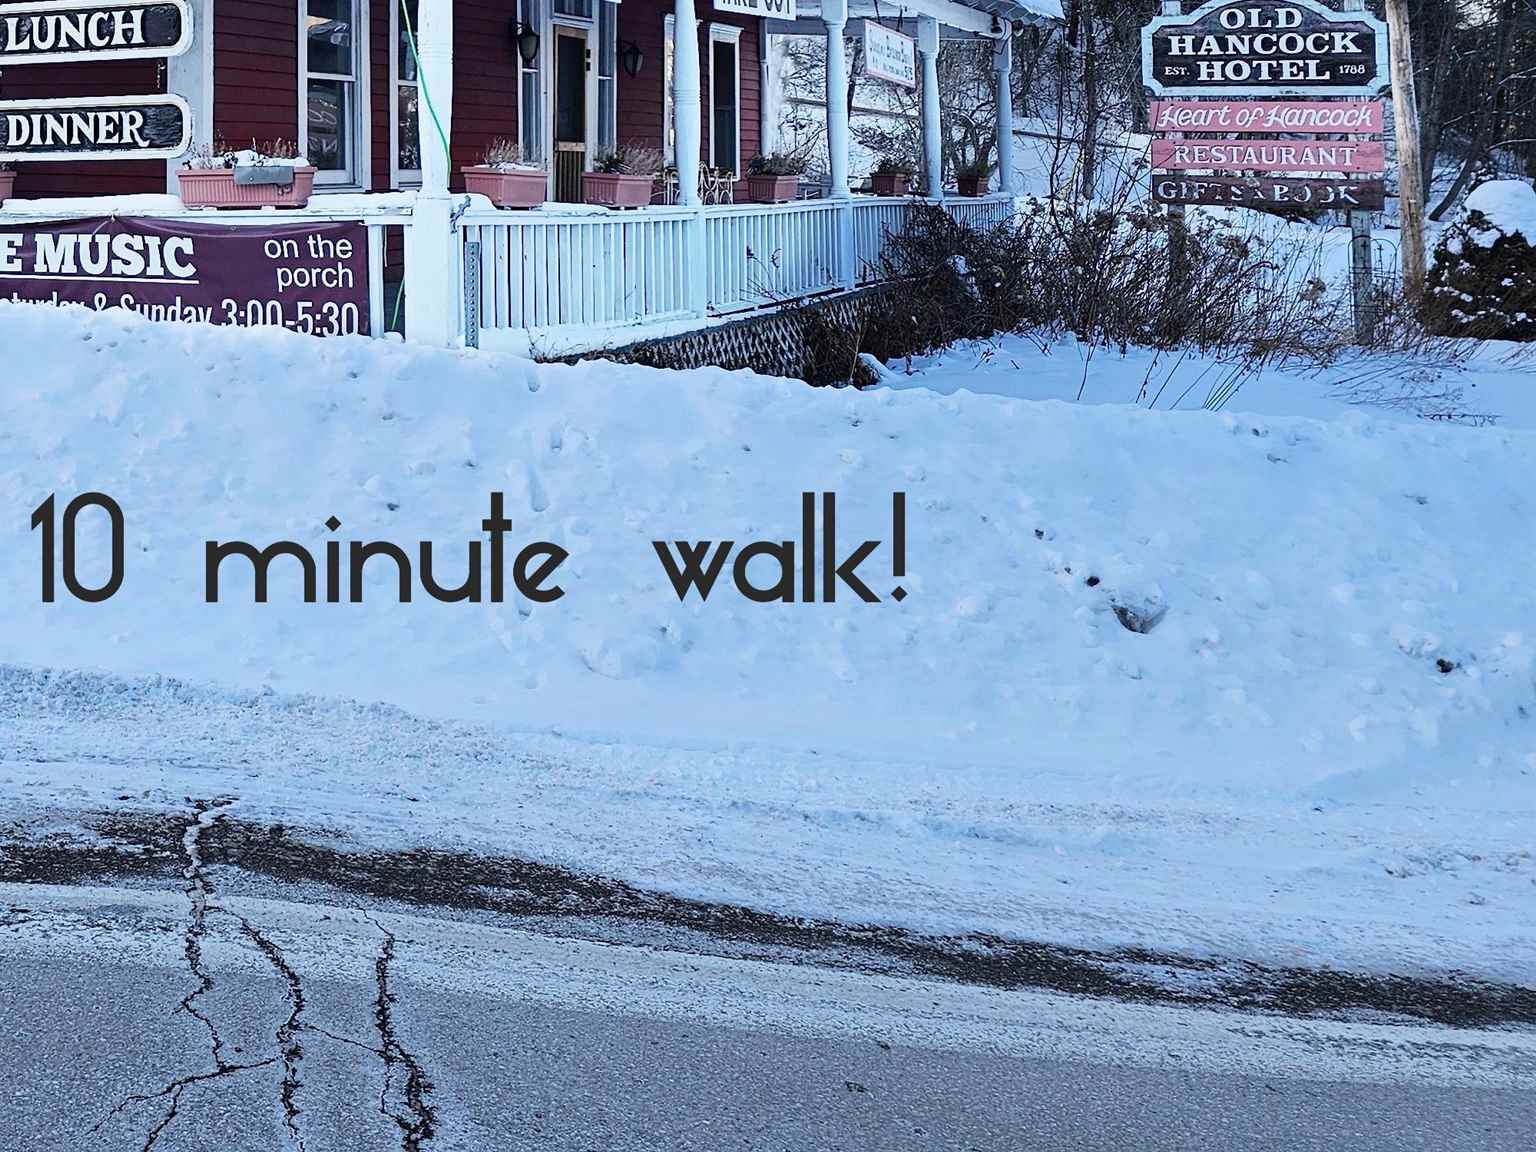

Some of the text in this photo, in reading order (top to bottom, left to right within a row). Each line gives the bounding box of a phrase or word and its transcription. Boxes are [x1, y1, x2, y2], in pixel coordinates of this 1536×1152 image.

[3, 9, 145, 52] LUNCH
[1219, 8, 1303, 29] OLD
[1167, 31, 1362, 56] HANCOCK
[1165, 59, 1366, 81] EST. HOTEL 1788
[5, 110, 150, 147] DINNER
[1157, 105, 1373, 128] Heart of Hancock
[1173, 145, 1358, 166] RESTAURANT
[33, 233, 197, 278] MUSIC
[264, 234, 353, 259] on the
[276, 261, 354, 293] porch
